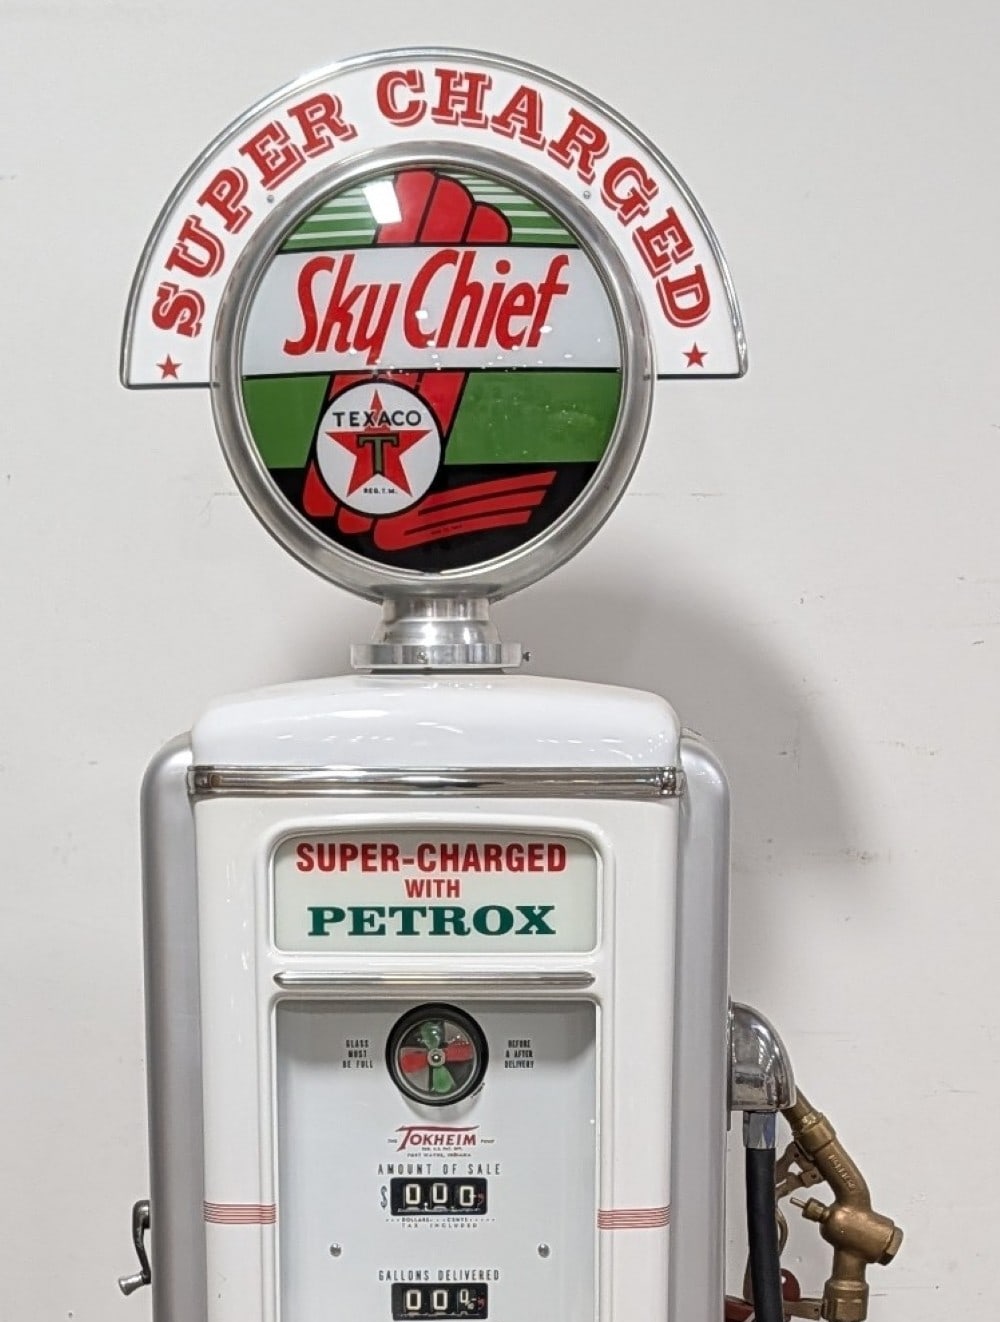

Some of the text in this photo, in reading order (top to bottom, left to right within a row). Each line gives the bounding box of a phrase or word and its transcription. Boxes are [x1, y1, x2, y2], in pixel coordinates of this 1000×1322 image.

[151, 67, 713, 339] SUPER CHARGED
[282, 248, 570, 366] Sky Chief
[332, 409, 422, 428] TEXACO
[356, 431, 401, 476] T
[296, 843, 567, 872] SUPER-CHARGED
[405, 879, 460, 898] WITH
[307, 905, 556, 936] PETROX
[395, 1125, 479, 1152] TOKHEIM
[377, 1163, 501, 1175] AMOUNT OF SALE
[380, 1185, 388, 1210] $
[379, 1269, 500, 1281] GALLONS DELIVERED
